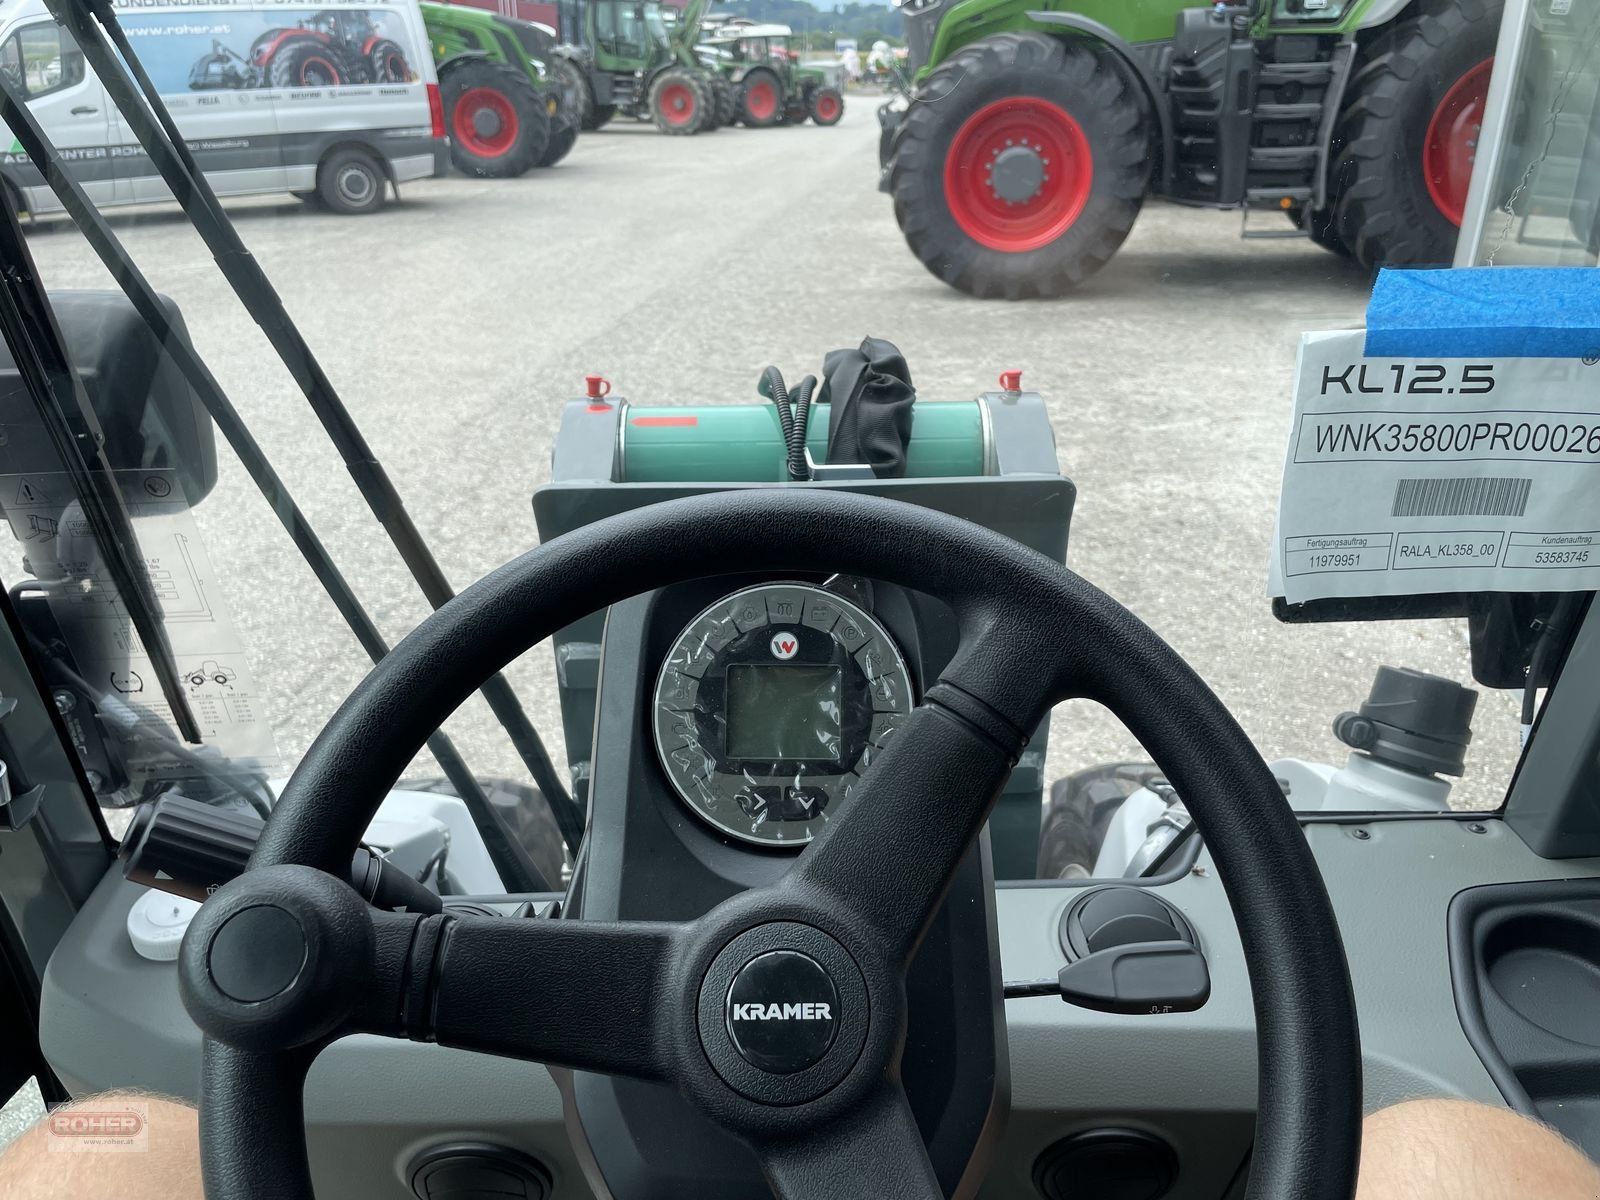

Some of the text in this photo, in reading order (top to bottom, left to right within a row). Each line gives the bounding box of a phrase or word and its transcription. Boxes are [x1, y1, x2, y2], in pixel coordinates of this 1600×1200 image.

[1320, 364, 1495, 395] KL12.5
[1306, 536, 1368, 548] Fertigungsauftrag
[1541, 535, 1593, 545] Kundenauftrag
[1399, 543, 1495, 559] RALA_KL358_00
[1534, 550, 1590, 564] 53583745
[1308, 553, 1361, 568] 11979951
[733, 1002, 833, 1021] KRAMER
